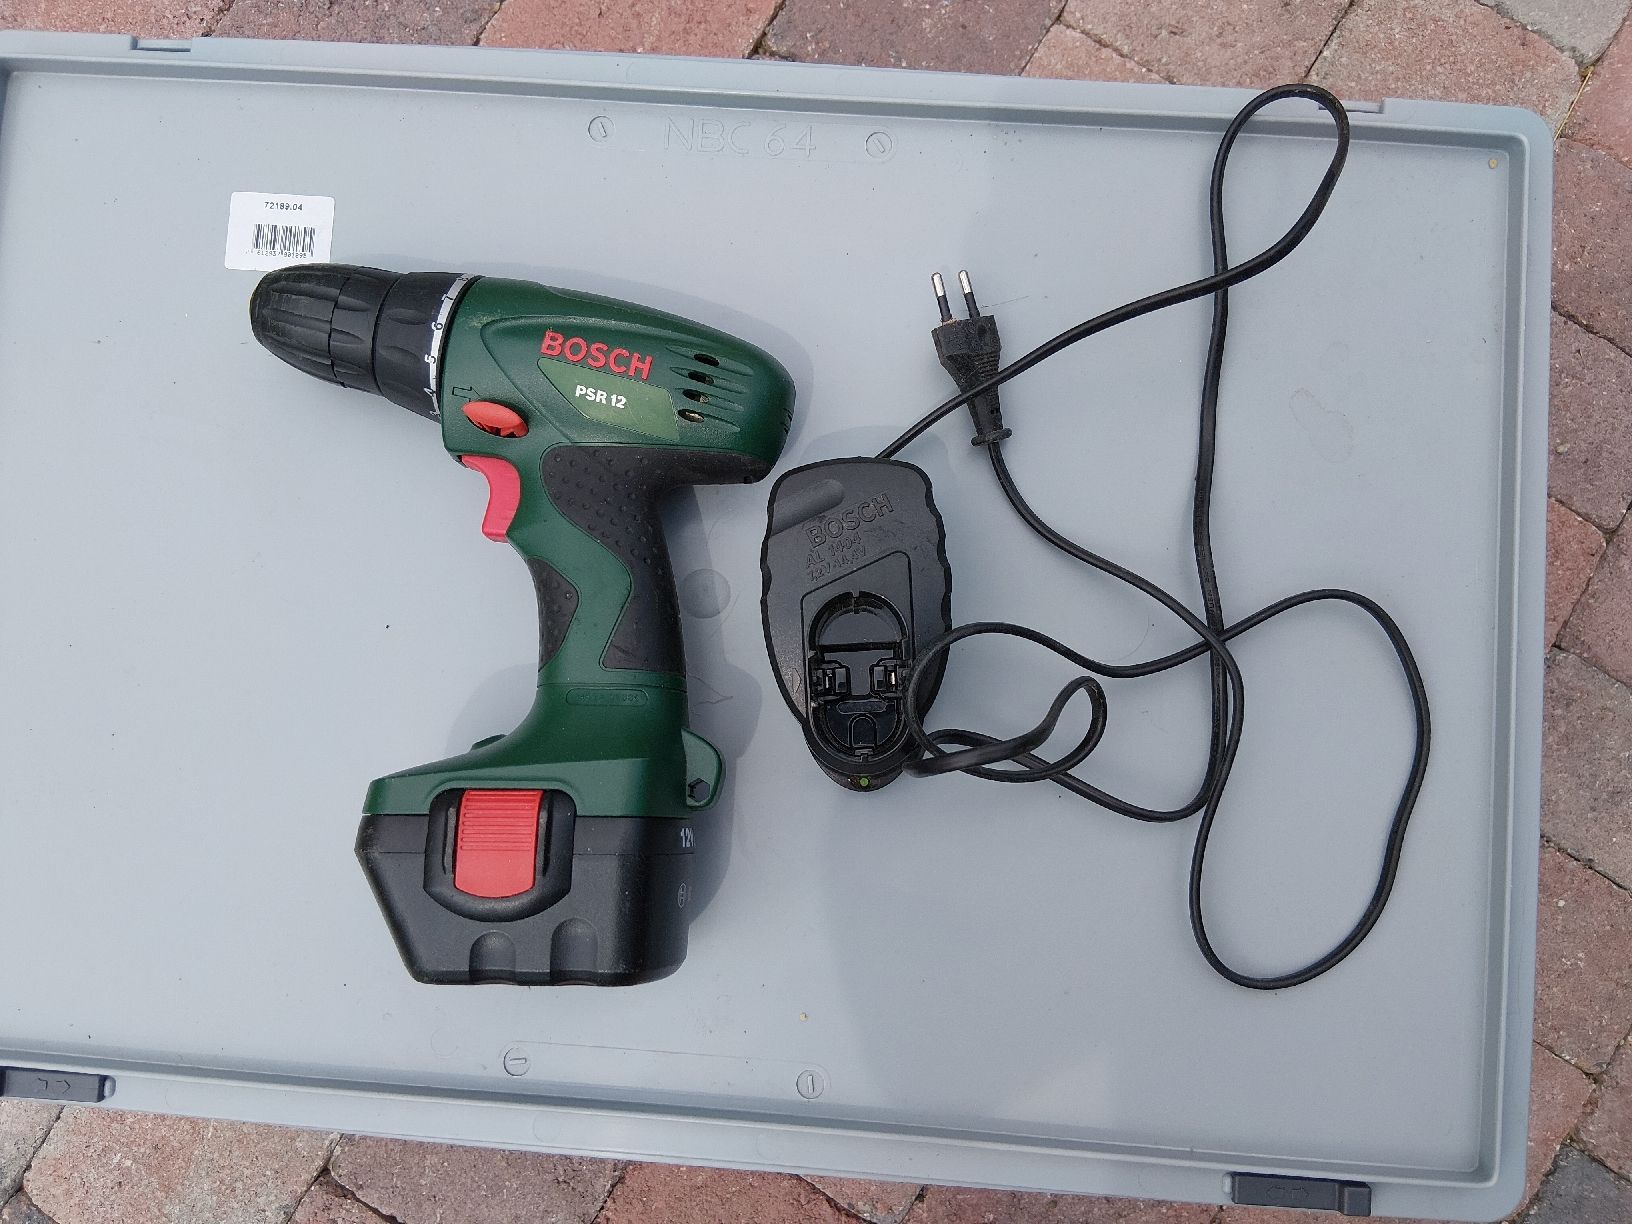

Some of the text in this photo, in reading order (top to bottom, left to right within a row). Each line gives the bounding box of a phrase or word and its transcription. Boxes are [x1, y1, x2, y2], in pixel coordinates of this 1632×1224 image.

[664, 116, 817, 159] NBC 64
[264, 201, 303, 211] 72189.04
[432, 321, 444, 331] 6
[424, 354, 437, 364] 5
[541, 330, 653, 379] BOSCH
[575, 384, 627, 409] PSR 12
[805, 493, 895, 549] BOSCH
